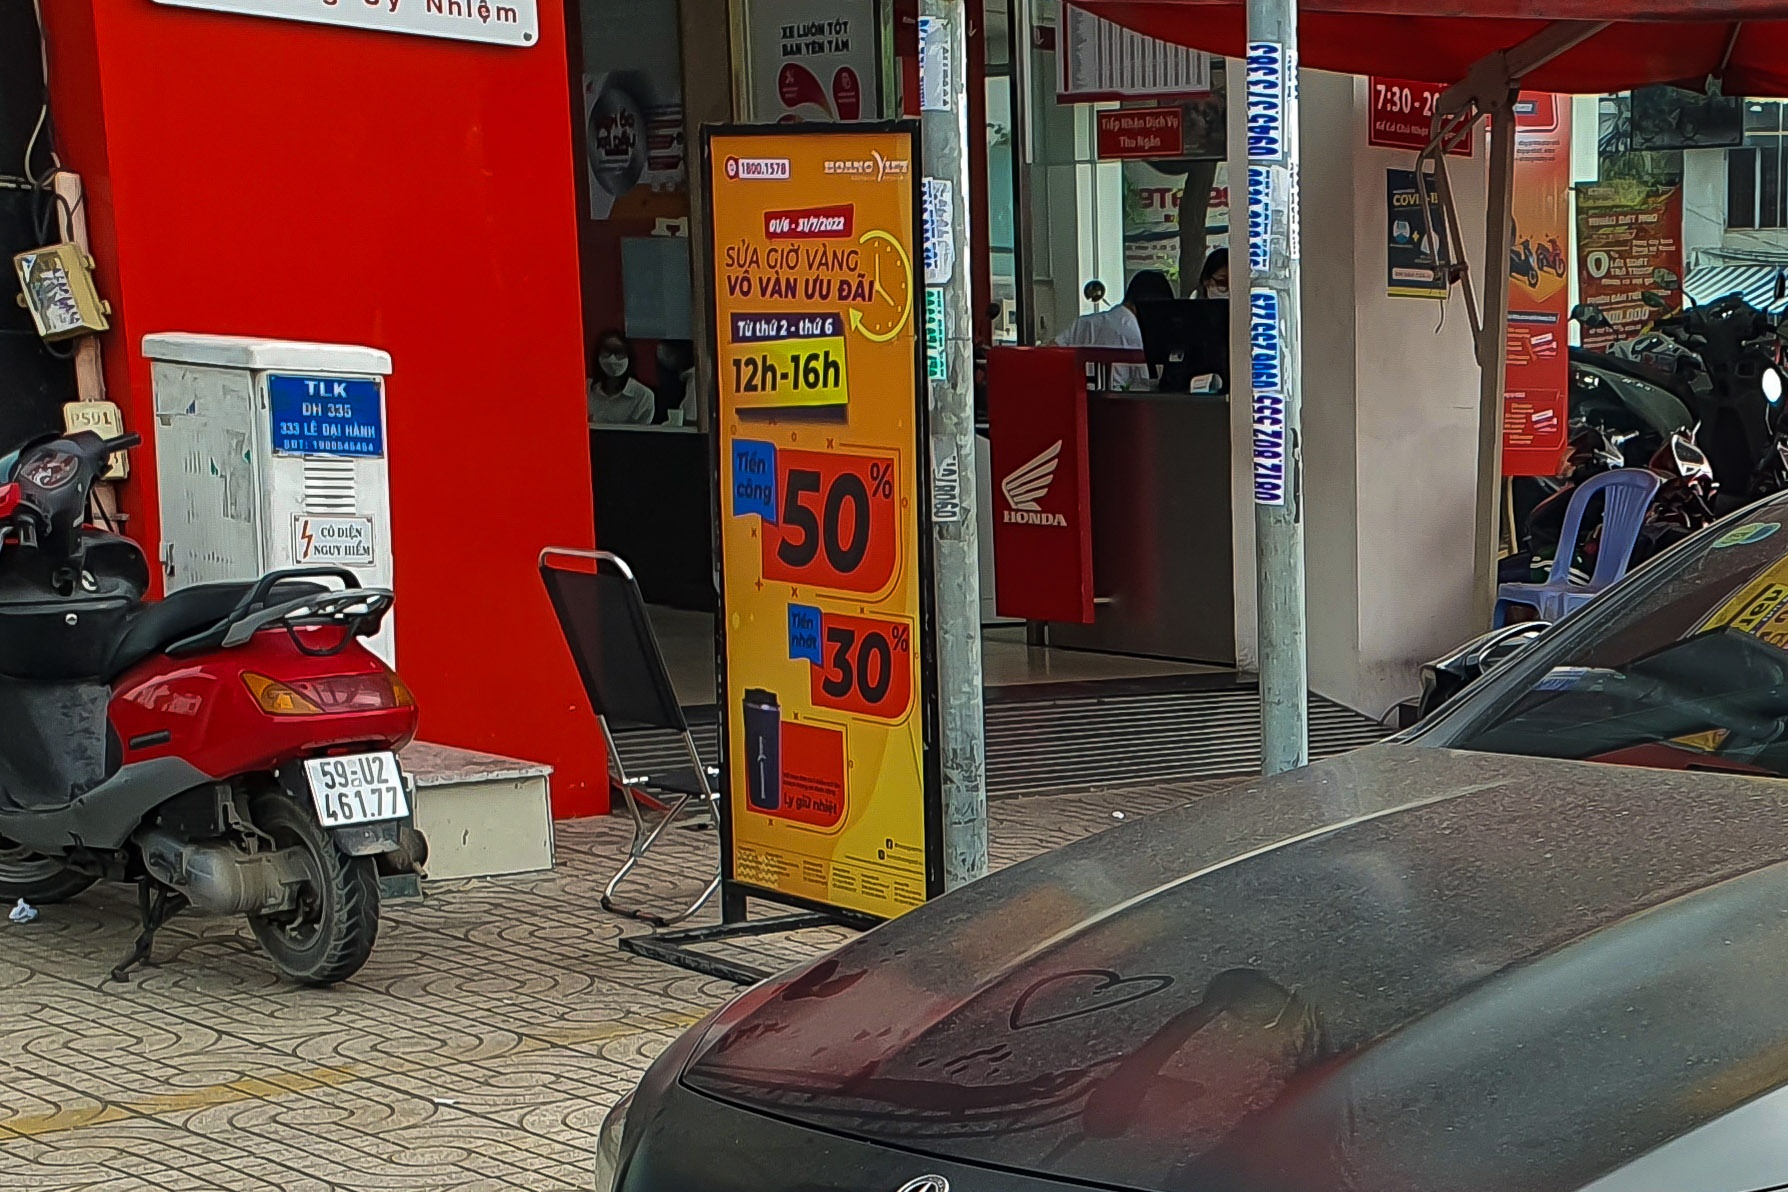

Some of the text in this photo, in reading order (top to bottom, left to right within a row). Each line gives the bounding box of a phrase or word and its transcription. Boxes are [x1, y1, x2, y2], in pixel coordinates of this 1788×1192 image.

[1247, 44, 1279, 158] 0945.373.383
[1375, 84, 1412, 114] 7:30
[1393, 192, 1439, 207] COVI-1
[725, 238, 861, 274] SỬA GIỜ VÀNG
[726, 269, 876, 304] VÔ VÀN ƯU ĐÃI
[738, 318, 755, 338] Từ
[755, 317, 778, 338] thứ
[799, 316, 822, 337] thứ
[823, 318, 833, 335] 6
[304, 380, 349, 399] TLK
[731, 349, 842, 395] 12h-16h
[303, 419, 318, 437] LÊ
[322, 422, 342, 439] ĐẠI
[345, 420, 377, 439] HÀNH
[1251, 394, 1284, 503] 0812.802.555
[776, 461, 895, 575] 50%
[1002, 509, 1068, 527] HONDA
[313, 544, 342, 557] NGUY
[821, 624, 910, 705] 30%
[324, 785, 398, 822] 461.77
